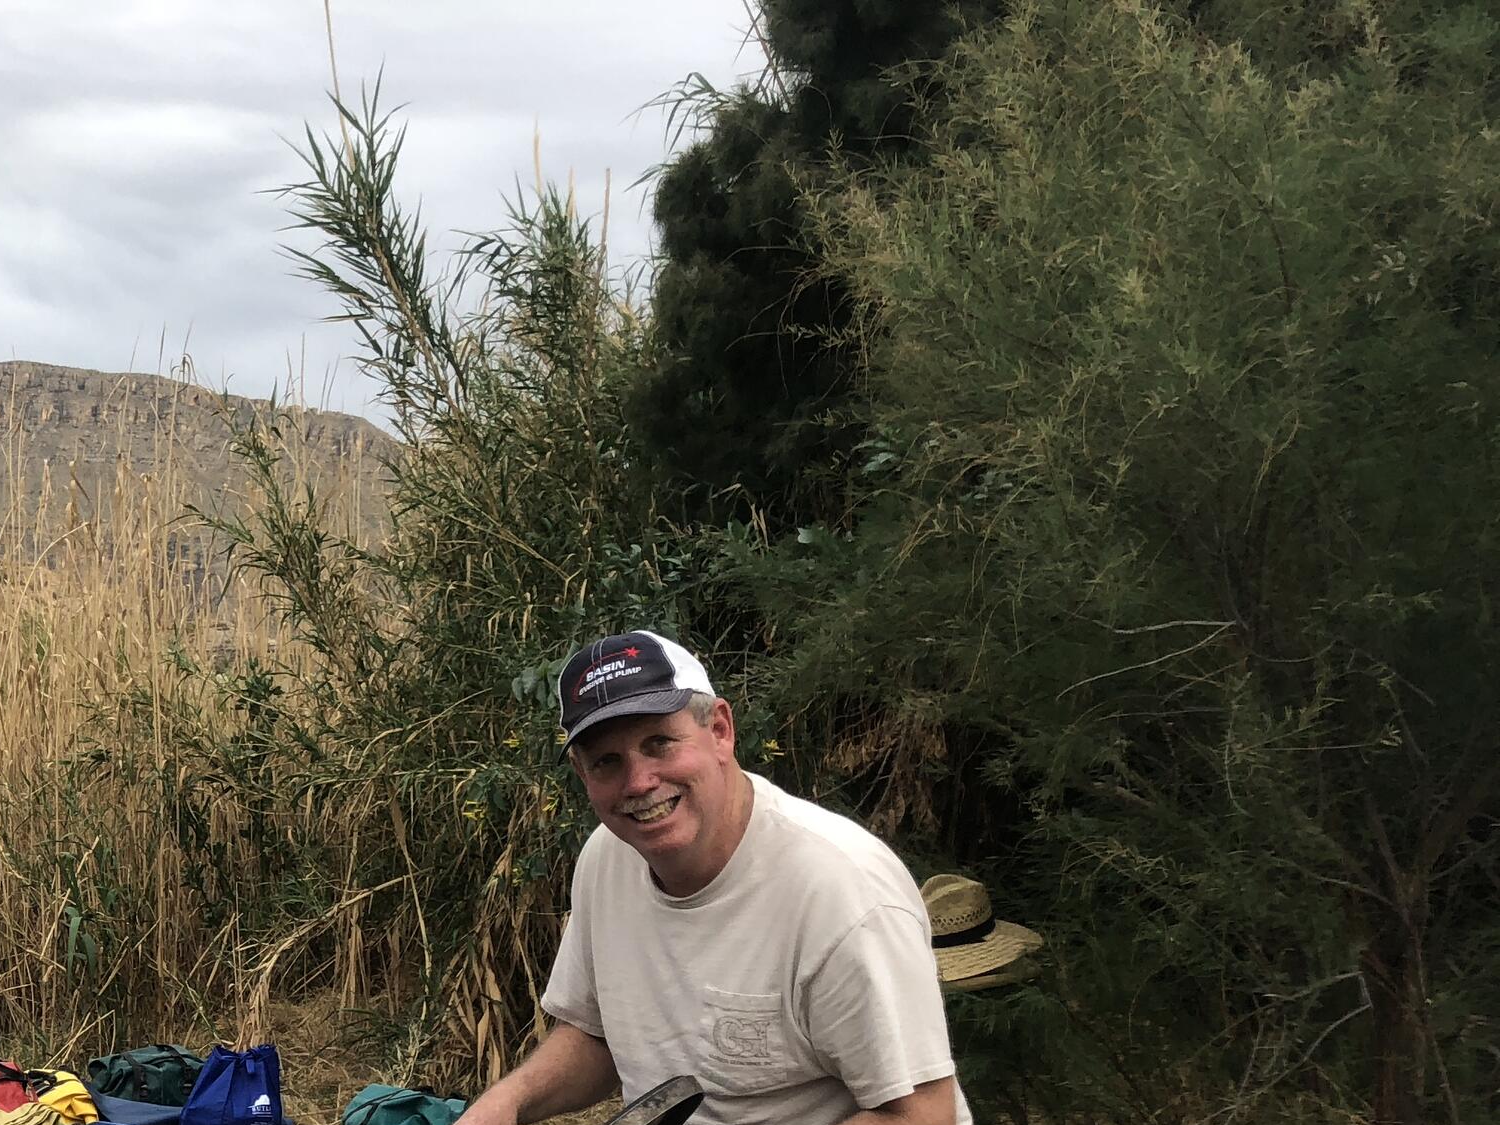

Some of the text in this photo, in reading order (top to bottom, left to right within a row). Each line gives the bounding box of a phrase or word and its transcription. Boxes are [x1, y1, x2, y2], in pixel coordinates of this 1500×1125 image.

[586, 659, 625, 682] BASIN
[606, 673, 613, 681] &
[615, 666, 642, 678] PUMP
